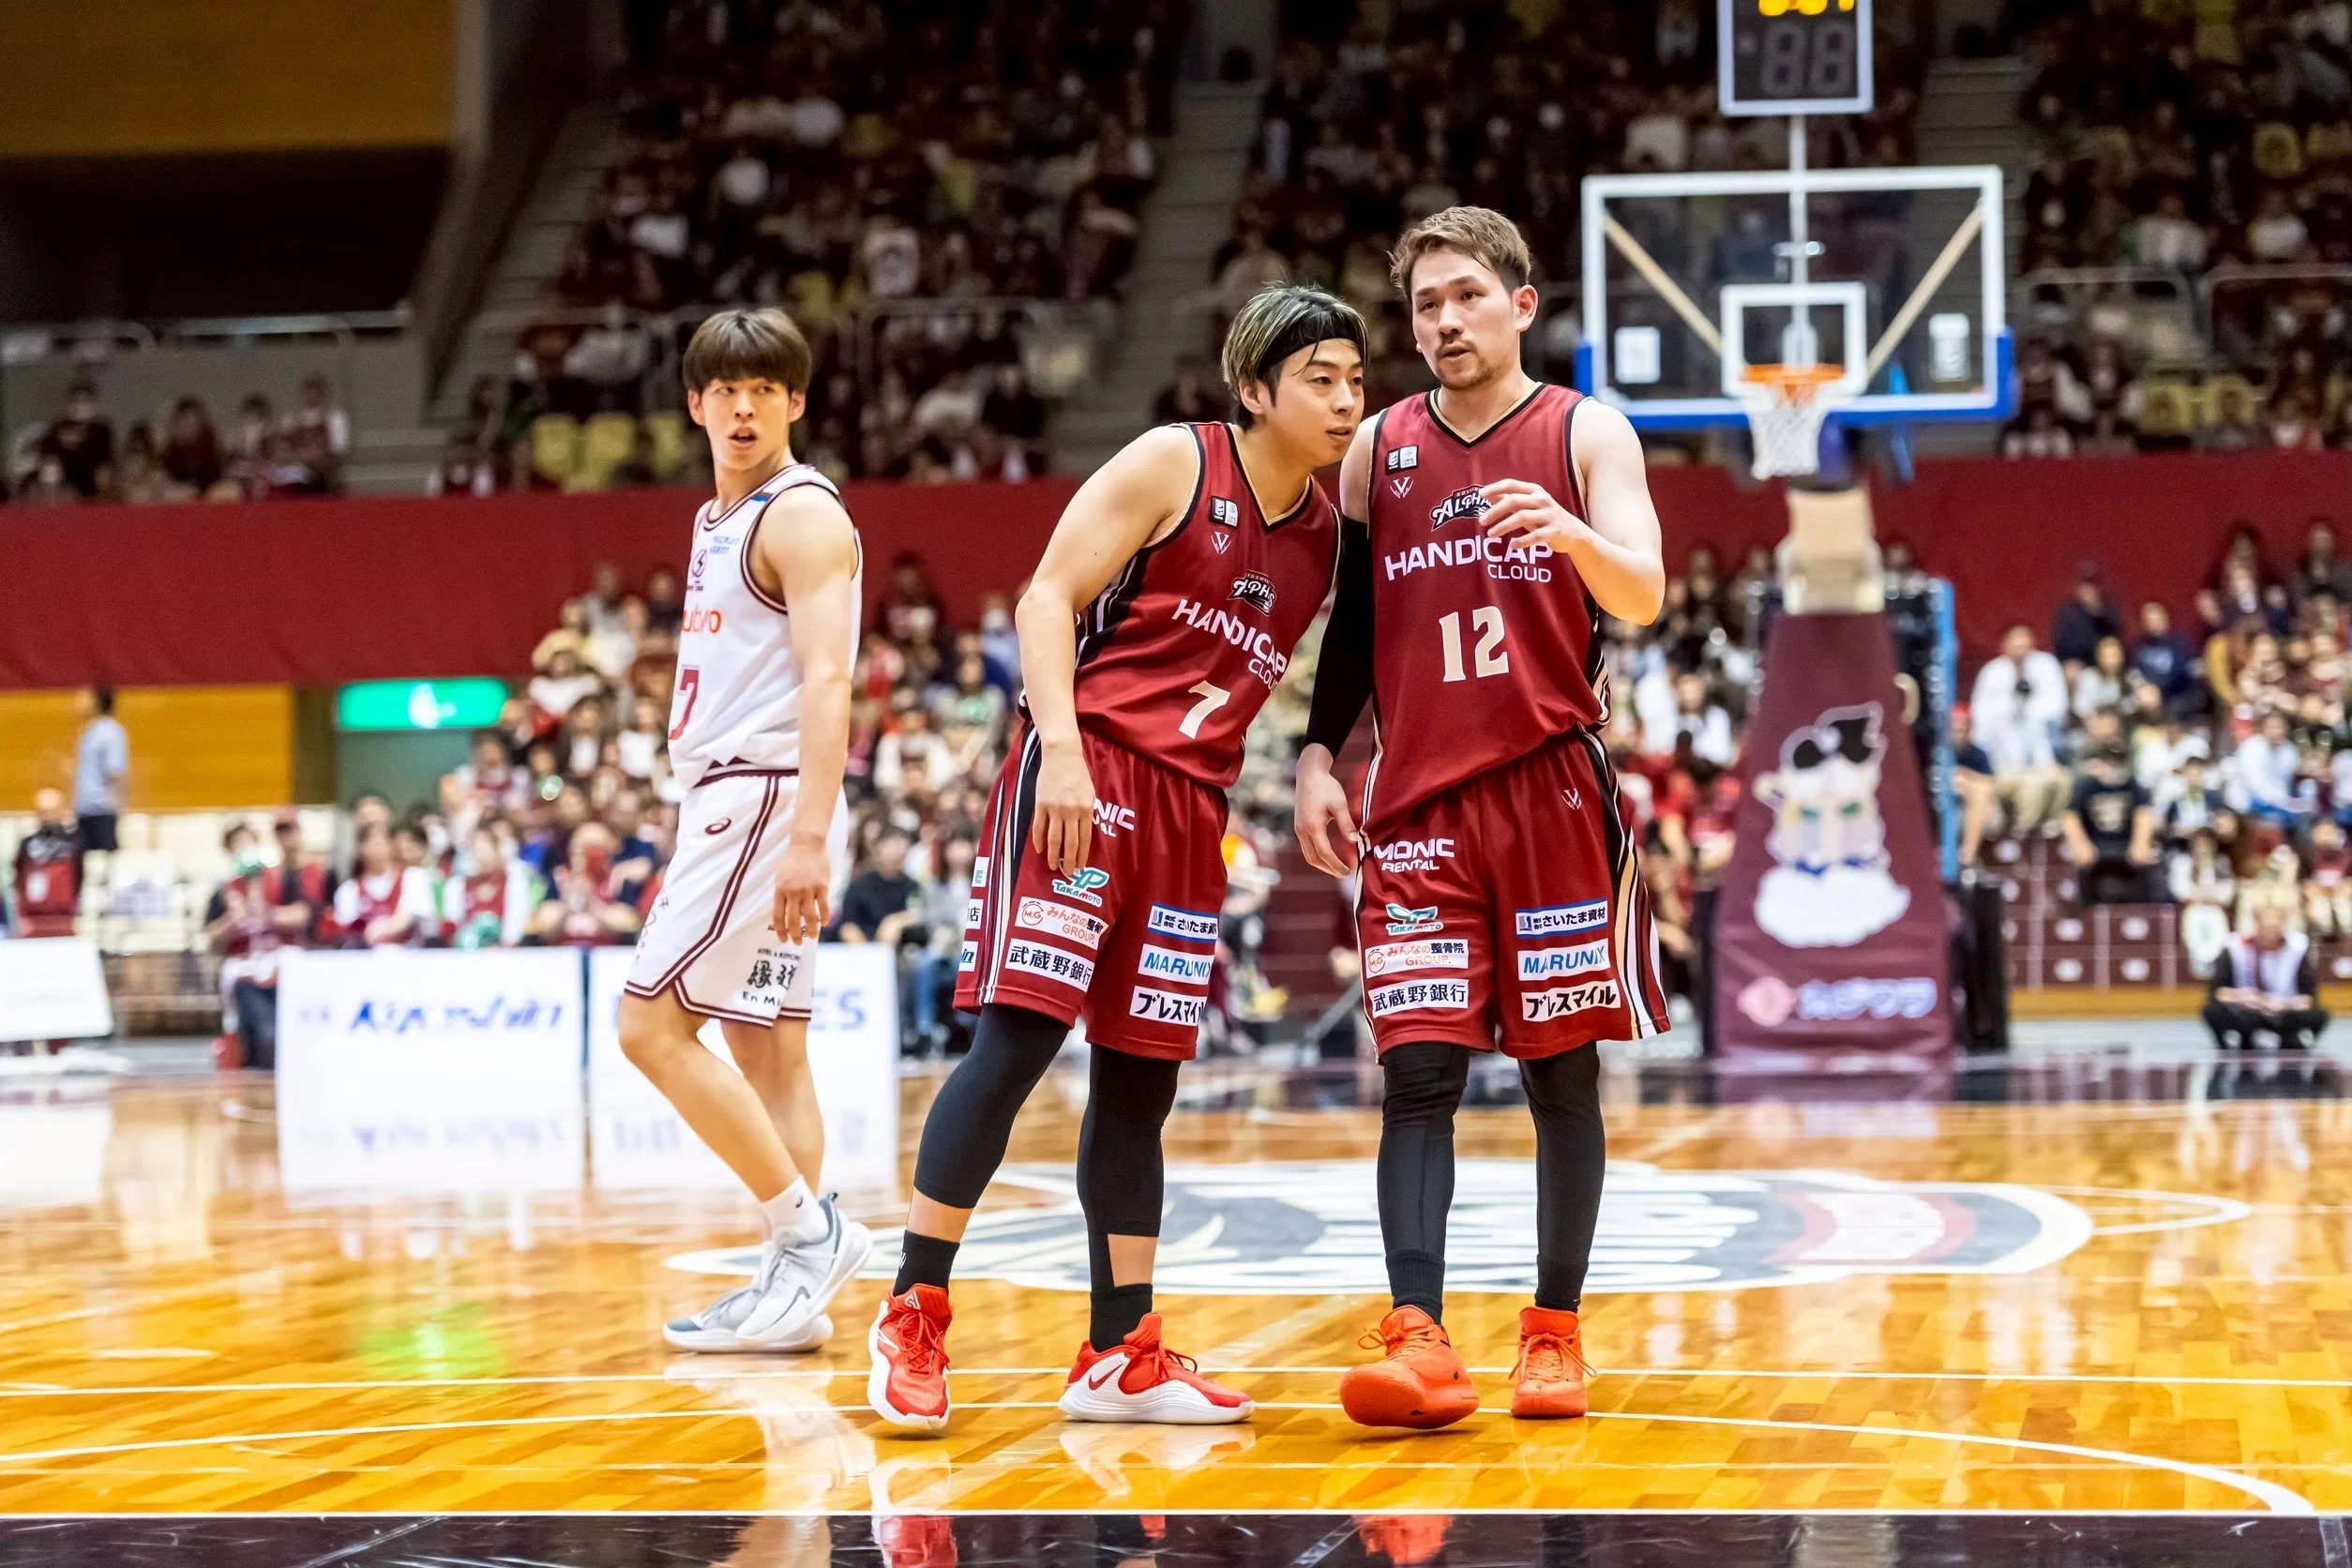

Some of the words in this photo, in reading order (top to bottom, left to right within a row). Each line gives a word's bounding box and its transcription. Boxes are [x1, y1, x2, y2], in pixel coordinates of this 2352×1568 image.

[1432, 491, 1492, 525] ALPHA
[1384, 535, 1553, 581] HANDICAP
[1487, 564, 1551, 582] CLOUD
[1171, 599, 1288, 674] HANDICAP
[1439, 605, 1509, 683] 12
[1179, 680, 1230, 740] 7
[1093, 797, 1136, 831] NIC
[1373, 838, 1455, 861] MONIC
[1381, 859, 1440, 873] RENTAL
[1543, 907, 1606, 927] さいたま資材
[1009, 945, 1093, 986] 武蔵野銀行
[1387, 942, 1465, 957] みんなの整骨院
[1523, 945, 1605, 973] MARUNIX
[1373, 984, 1466, 1013] 武蔵野銀行
[1526, 986, 1616, 1018] ブレスマイル
